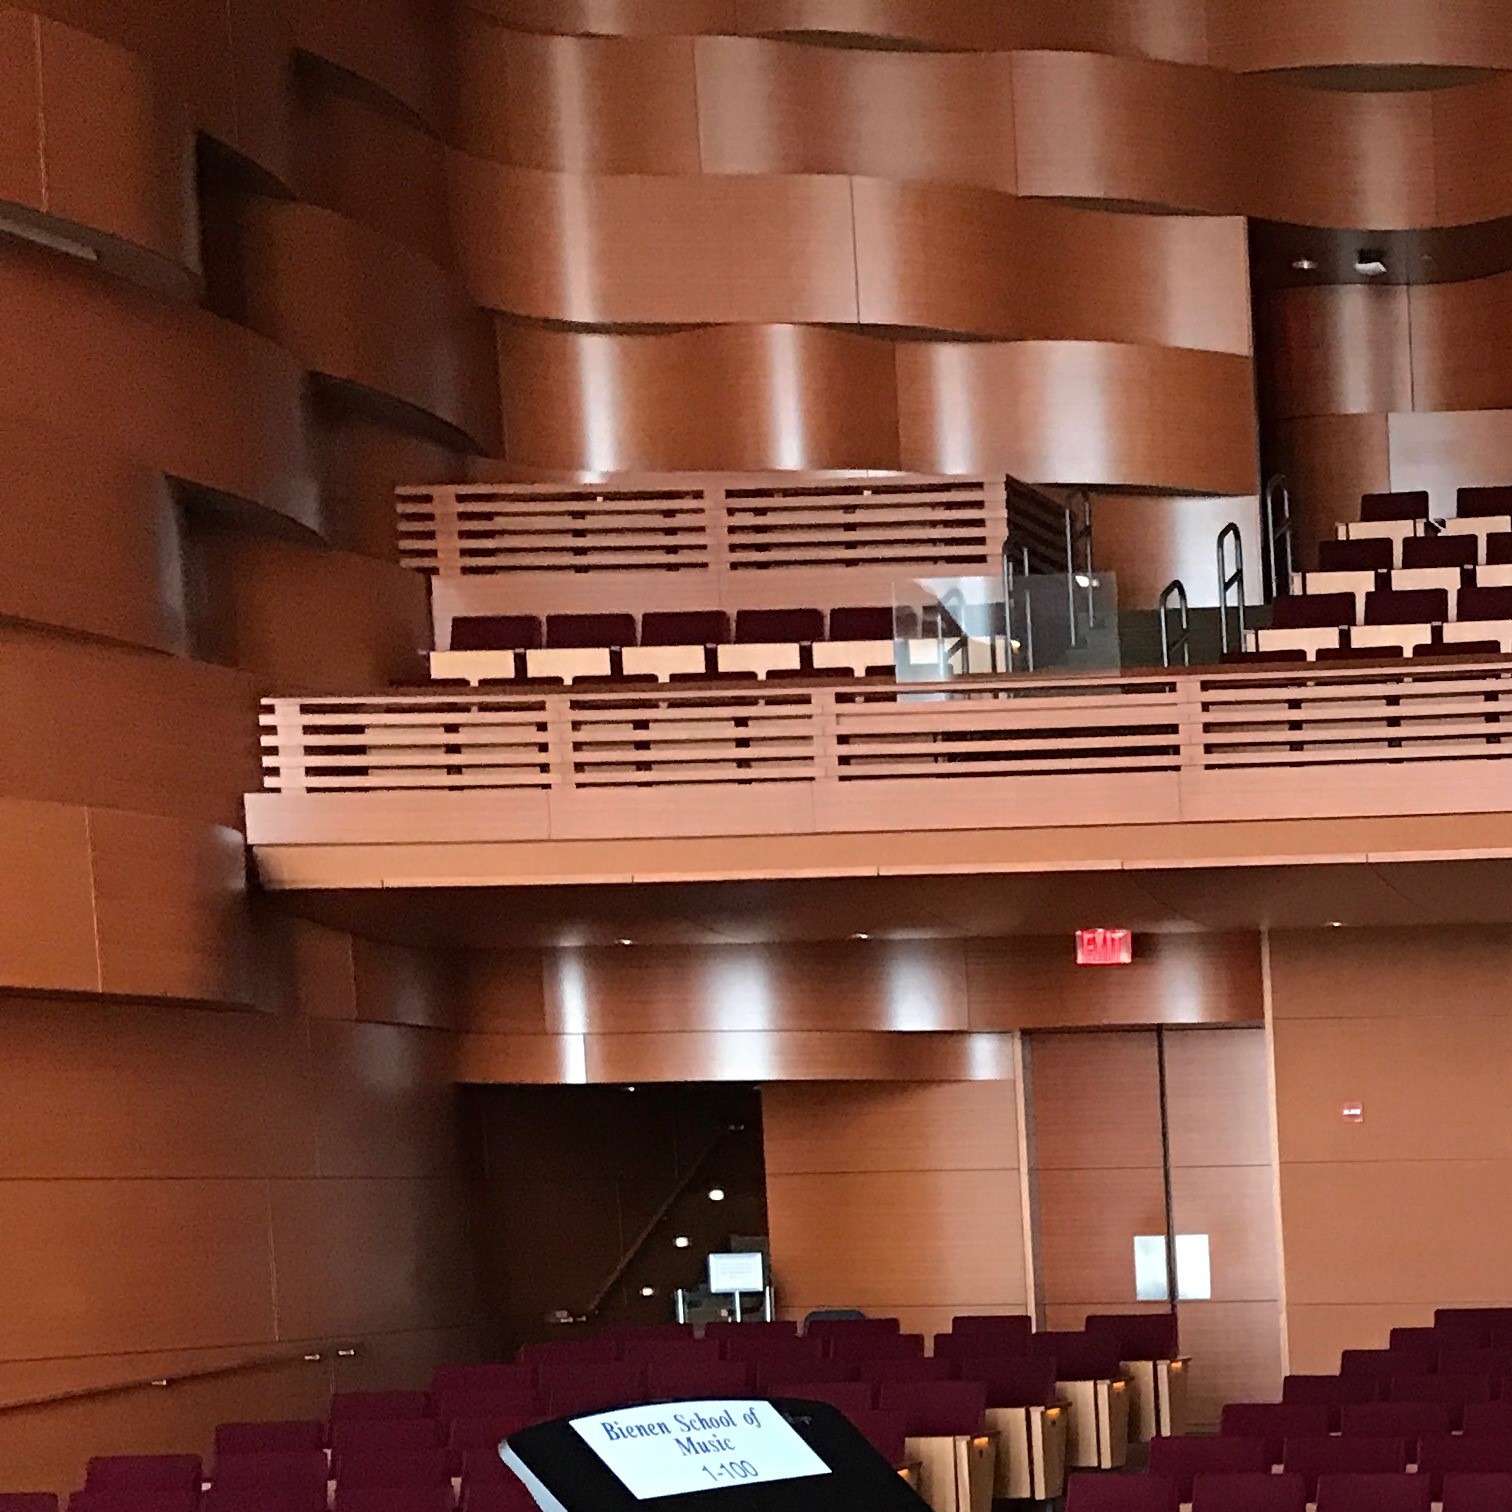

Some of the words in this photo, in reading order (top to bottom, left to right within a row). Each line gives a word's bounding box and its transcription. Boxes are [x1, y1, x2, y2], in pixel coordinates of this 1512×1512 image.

[1082, 931, 1126, 962] EXIT
[600, 1419, 673, 1441] Bienen
[673, 1409, 738, 1433] School
[742, 1406, 762, 1429] of
[673, 1433, 736, 1456] Music
[701, 1459, 760, 1482] 1-100
